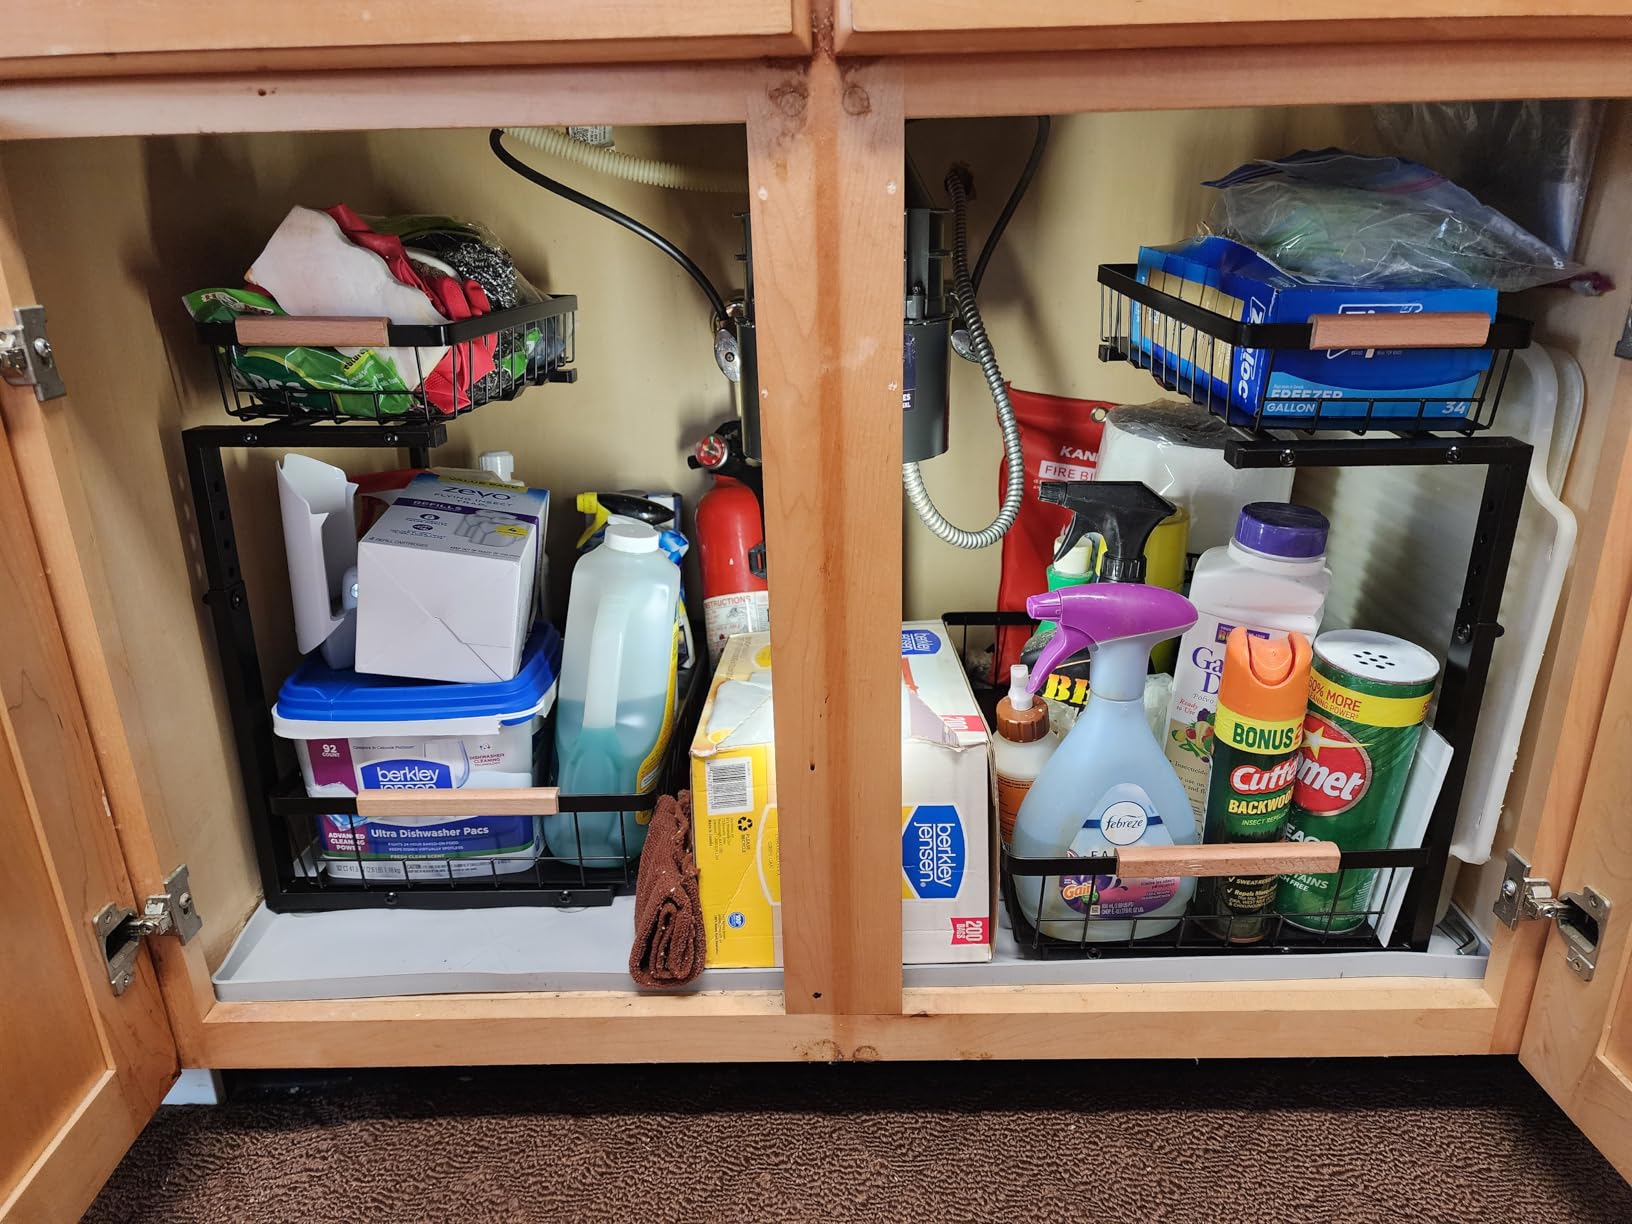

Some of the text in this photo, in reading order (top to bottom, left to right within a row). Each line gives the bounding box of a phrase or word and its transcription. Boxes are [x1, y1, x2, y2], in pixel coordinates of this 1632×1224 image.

[1266, 403, 1315, 413] GALLON
[1442, 402, 1466, 414] 34
[1060, 446, 1097, 461] KAN
[1045, 465, 1076, 479] FIRE
[433, 492, 513, 507] FLYING INSECT
[442, 486, 511, 501] zevo
[413, 500, 463, 511] REFILLS
[1192, 646, 1224, 674] Ga
[1180, 698, 1198, 709] Ready
[1193, 693, 1215, 704] Polvo
[1326, 689, 1362, 713] MORE
[1232, 722, 1294, 750] BONUS
[322, 744, 337, 753] 92
[377, 767, 439, 783] berkley
[1232, 759, 1298, 791] Cutte
[1188, 785, 1199, 793] and
[1105, 814, 1143, 831] febreze
[371, 826, 489, 838] Ultra Dishwasher Pacs
[331, 838, 365, 846] CLEANNG
[914, 822, 934, 882] jensen
[937, 823, 957, 887] berkley
[1290, 879, 1309, 892] FREE
[956, 923, 966, 939] BAGS
[965, 920, 983, 942] 200
